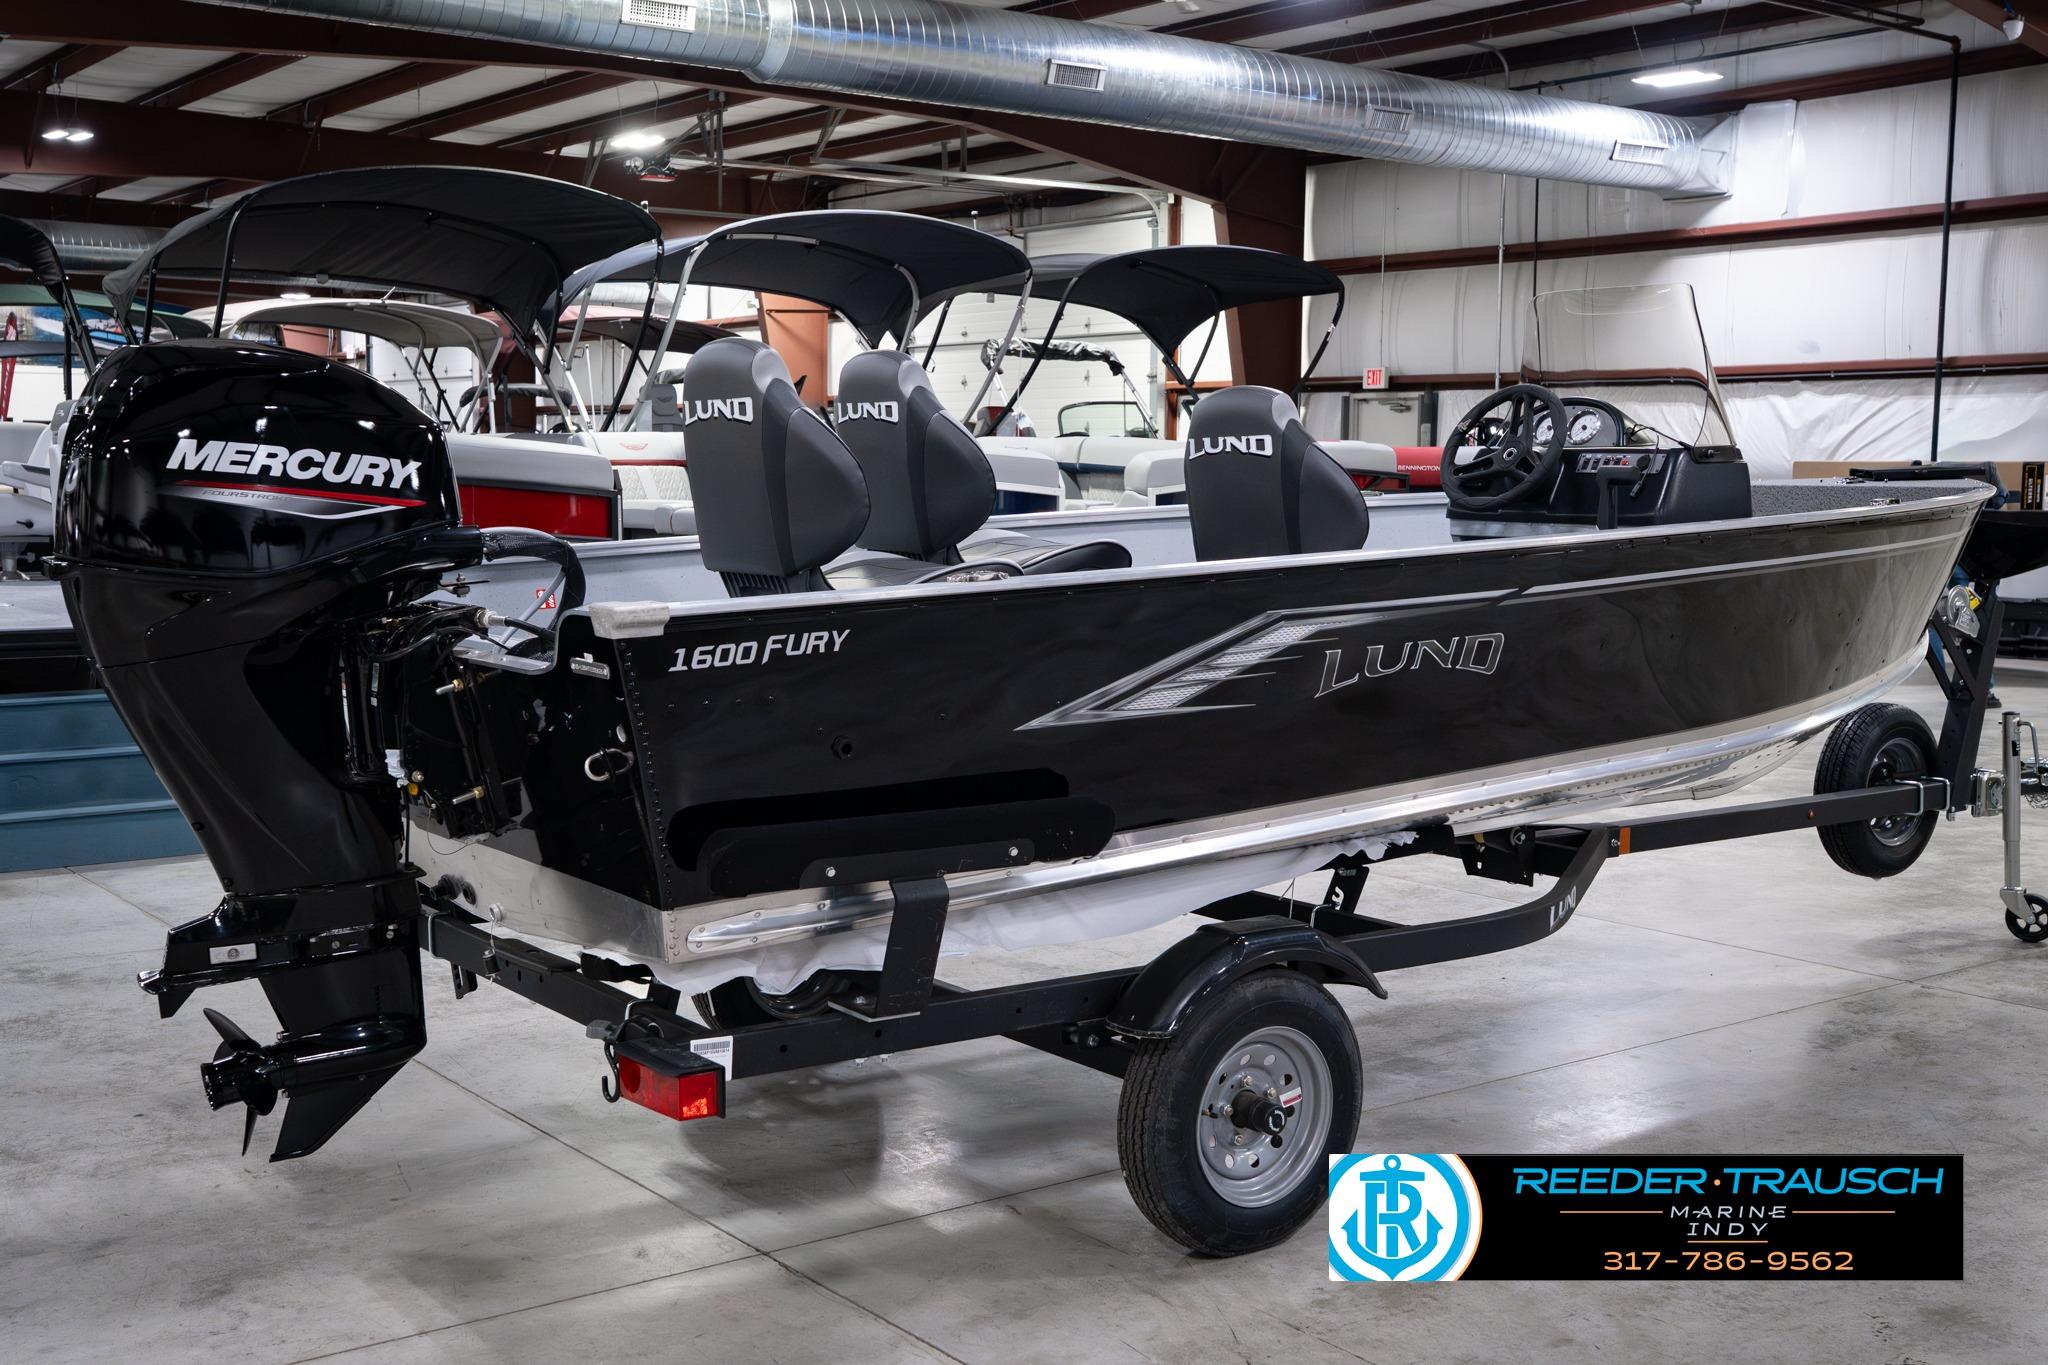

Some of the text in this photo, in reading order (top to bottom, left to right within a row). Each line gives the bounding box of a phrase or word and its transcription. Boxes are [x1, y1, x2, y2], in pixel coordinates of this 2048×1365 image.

[1366, 369, 1383, 386] EXIT
[684, 396, 754, 426] LUND
[837, 401, 899, 424] LUND
[1188, 434, 1273, 460] LUND
[165, 438, 423, 490] MERCURY
[1397, 464, 1440, 472] BENNINGTON
[668, 629, 851, 672] 1600 FURY
[1314, 632, 1505, 699] LUND
[1550, 885, 1577, 931] LUND
